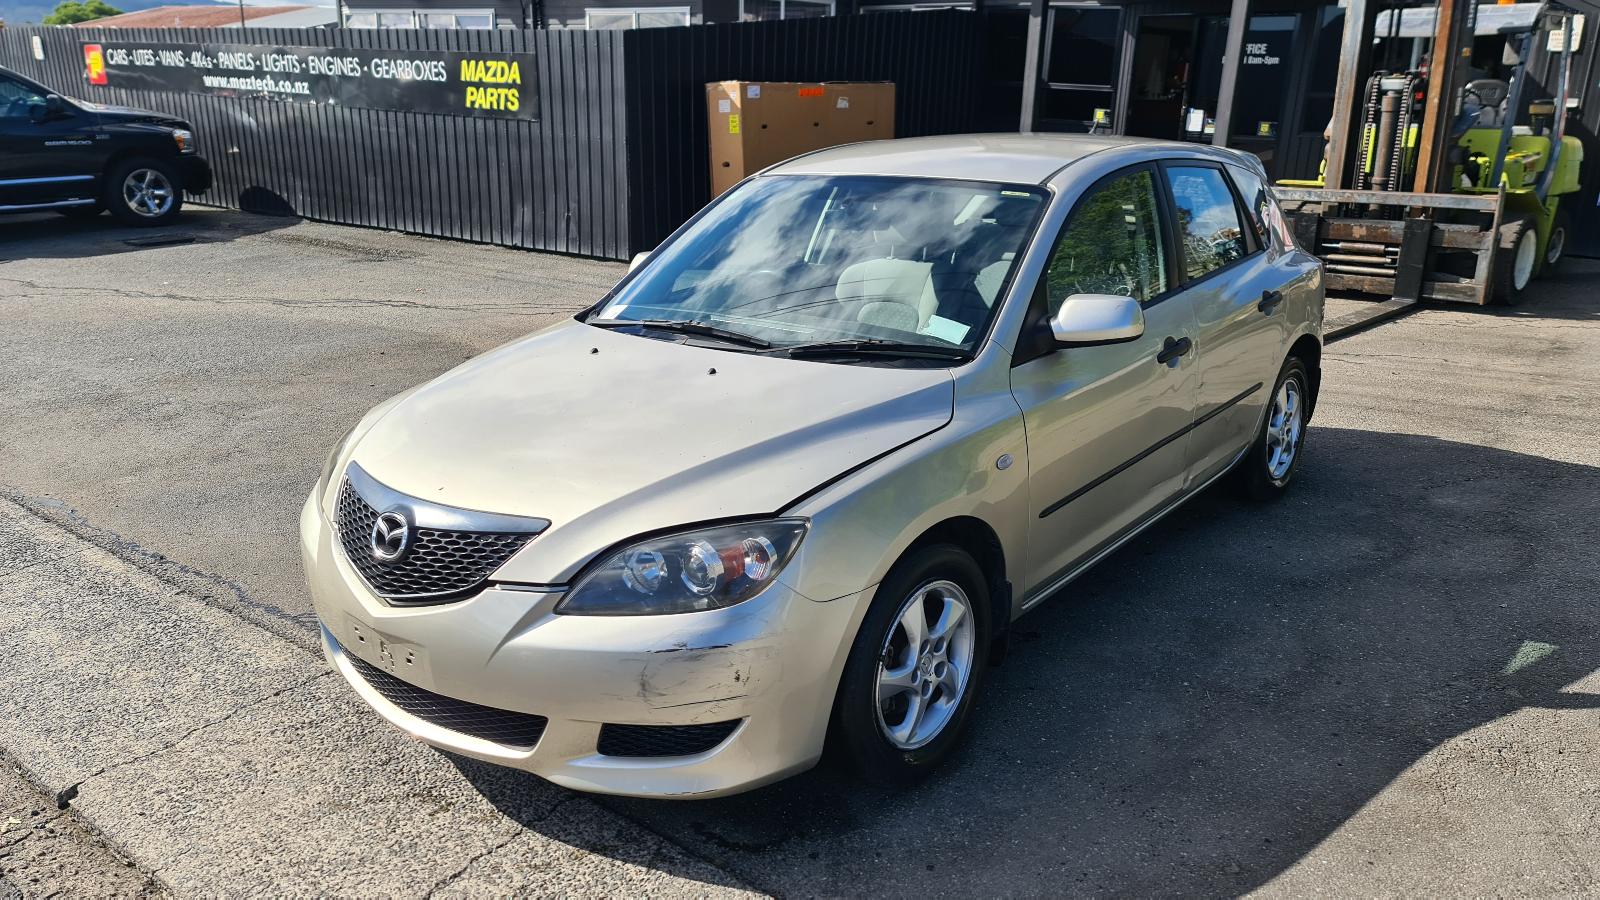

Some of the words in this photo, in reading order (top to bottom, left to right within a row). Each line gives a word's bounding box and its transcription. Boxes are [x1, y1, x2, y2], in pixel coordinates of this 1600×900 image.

[1245, 43, 1268, 54] FICE
[106, 48, 128, 65] CARS
[133, 49, 155, 66] UTES
[158, 50, 185, 68] VANS
[218, 51, 255, 71] PANELS
[261, 53, 300, 73] LIGHTS
[307, 55, 361, 77] ENGINES
[371, 57, 447, 82] GEARBOXES
[460, 59, 521, 84] MAZDA
[203, 74, 310, 95] www.maztech.co.nz
[465, 86, 520, 111] PARTS
